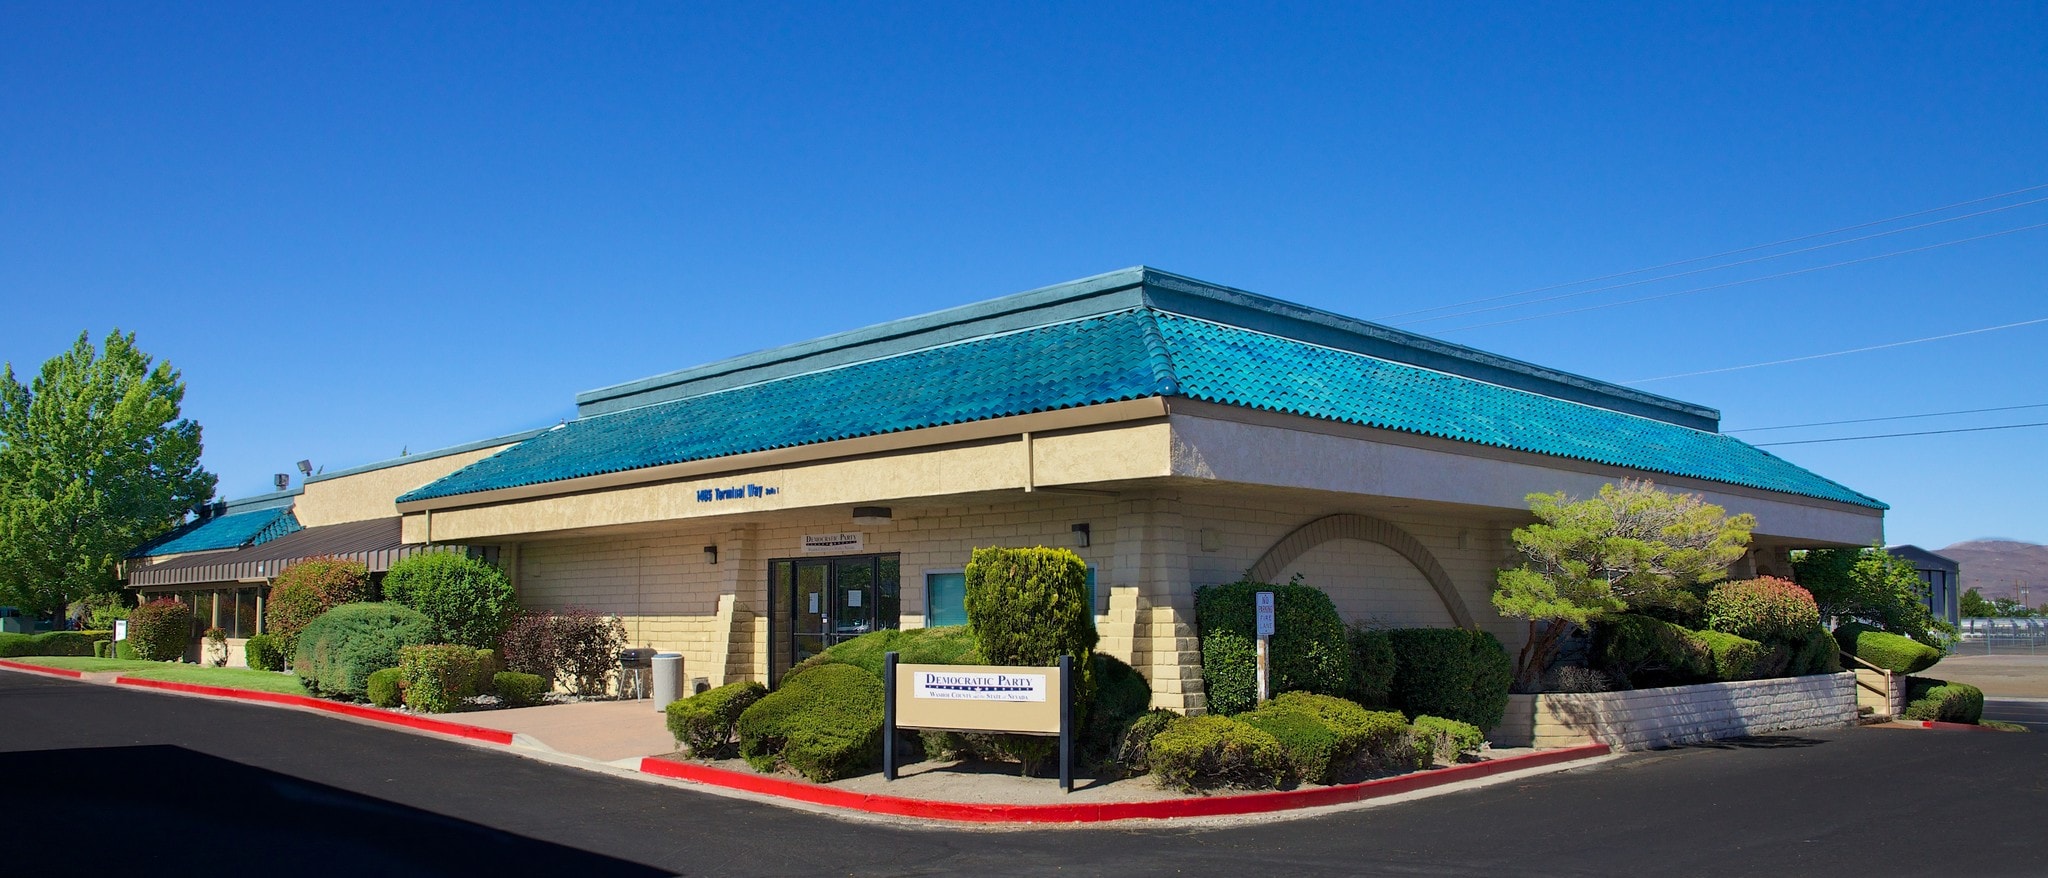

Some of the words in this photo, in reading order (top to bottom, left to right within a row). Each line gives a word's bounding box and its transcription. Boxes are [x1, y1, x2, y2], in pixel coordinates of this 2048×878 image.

[715, 485, 745, 501] Terminal
[747, 483, 763, 498] Way
[840, 533, 857, 541] PARTY
[1262, 596, 1269, 604] NO
[926, 673, 994, 686] DEMOCRATIC
[998, 675, 1033, 687] PARTY
